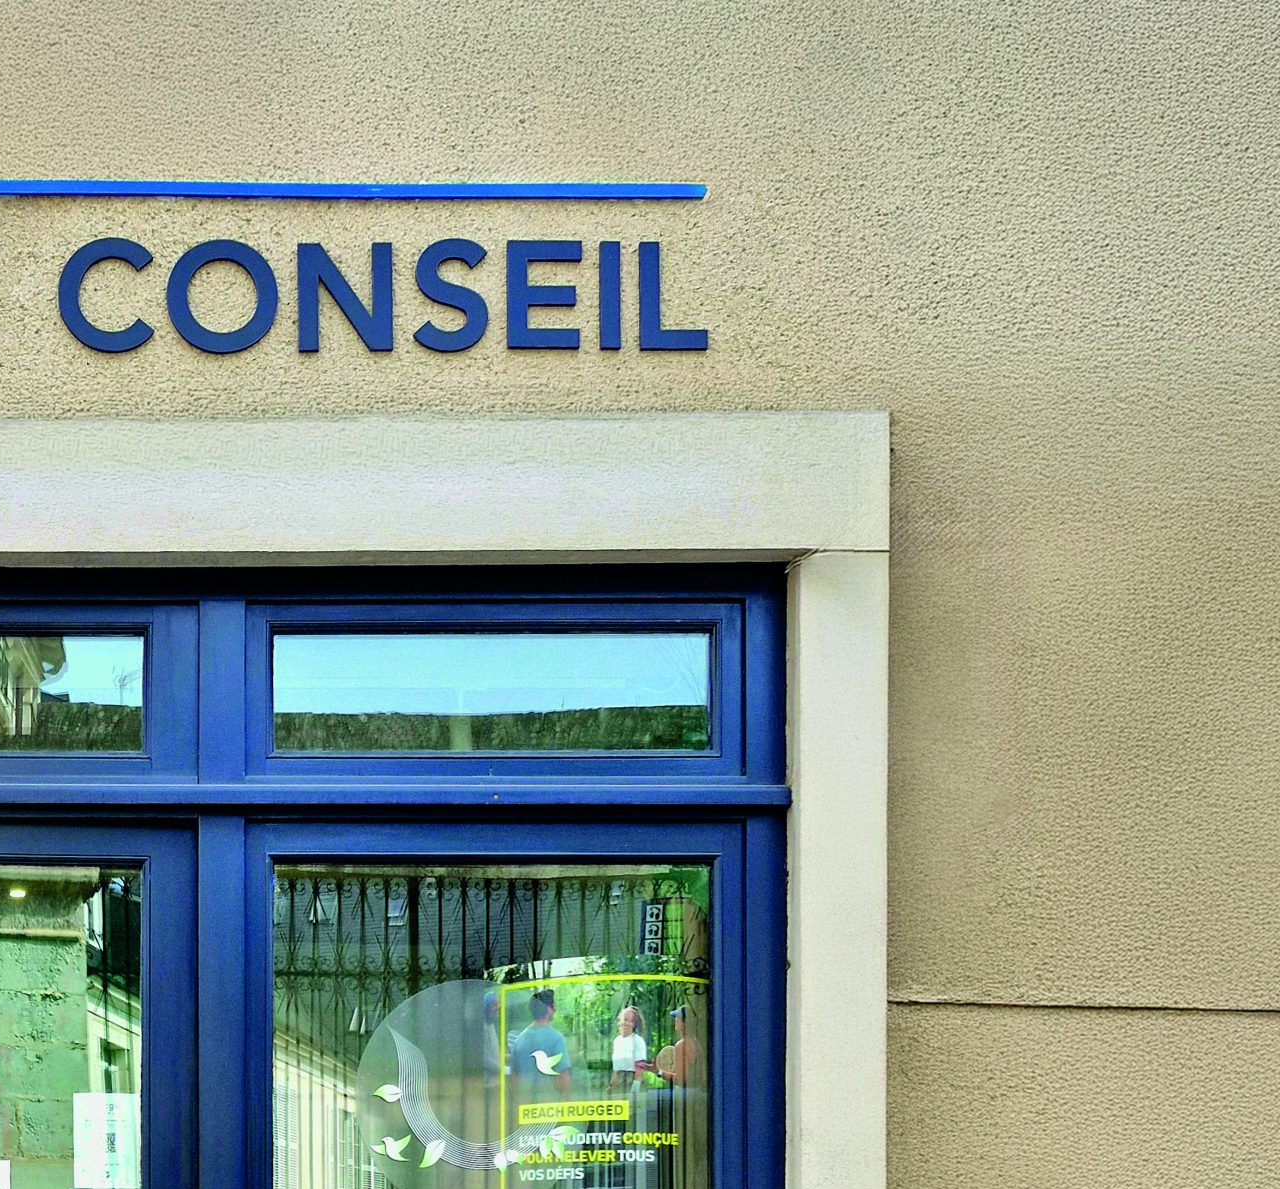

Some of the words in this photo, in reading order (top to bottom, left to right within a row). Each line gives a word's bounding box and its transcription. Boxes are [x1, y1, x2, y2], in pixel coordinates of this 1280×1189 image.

[57, 237, 709, 354] CONSEIL
[522, 1106, 564, 1119] REACH
[567, 1104, 624, 1117] RUGGED
[622, 1132, 679, 1148] CONÇUE
[556, 1149, 616, 1162] ELEVER
[617, 1149, 656, 1162] TOUS
[519, 1169, 545, 1181] VOS
[546, 1165, 585, 1181] DÉFIS
